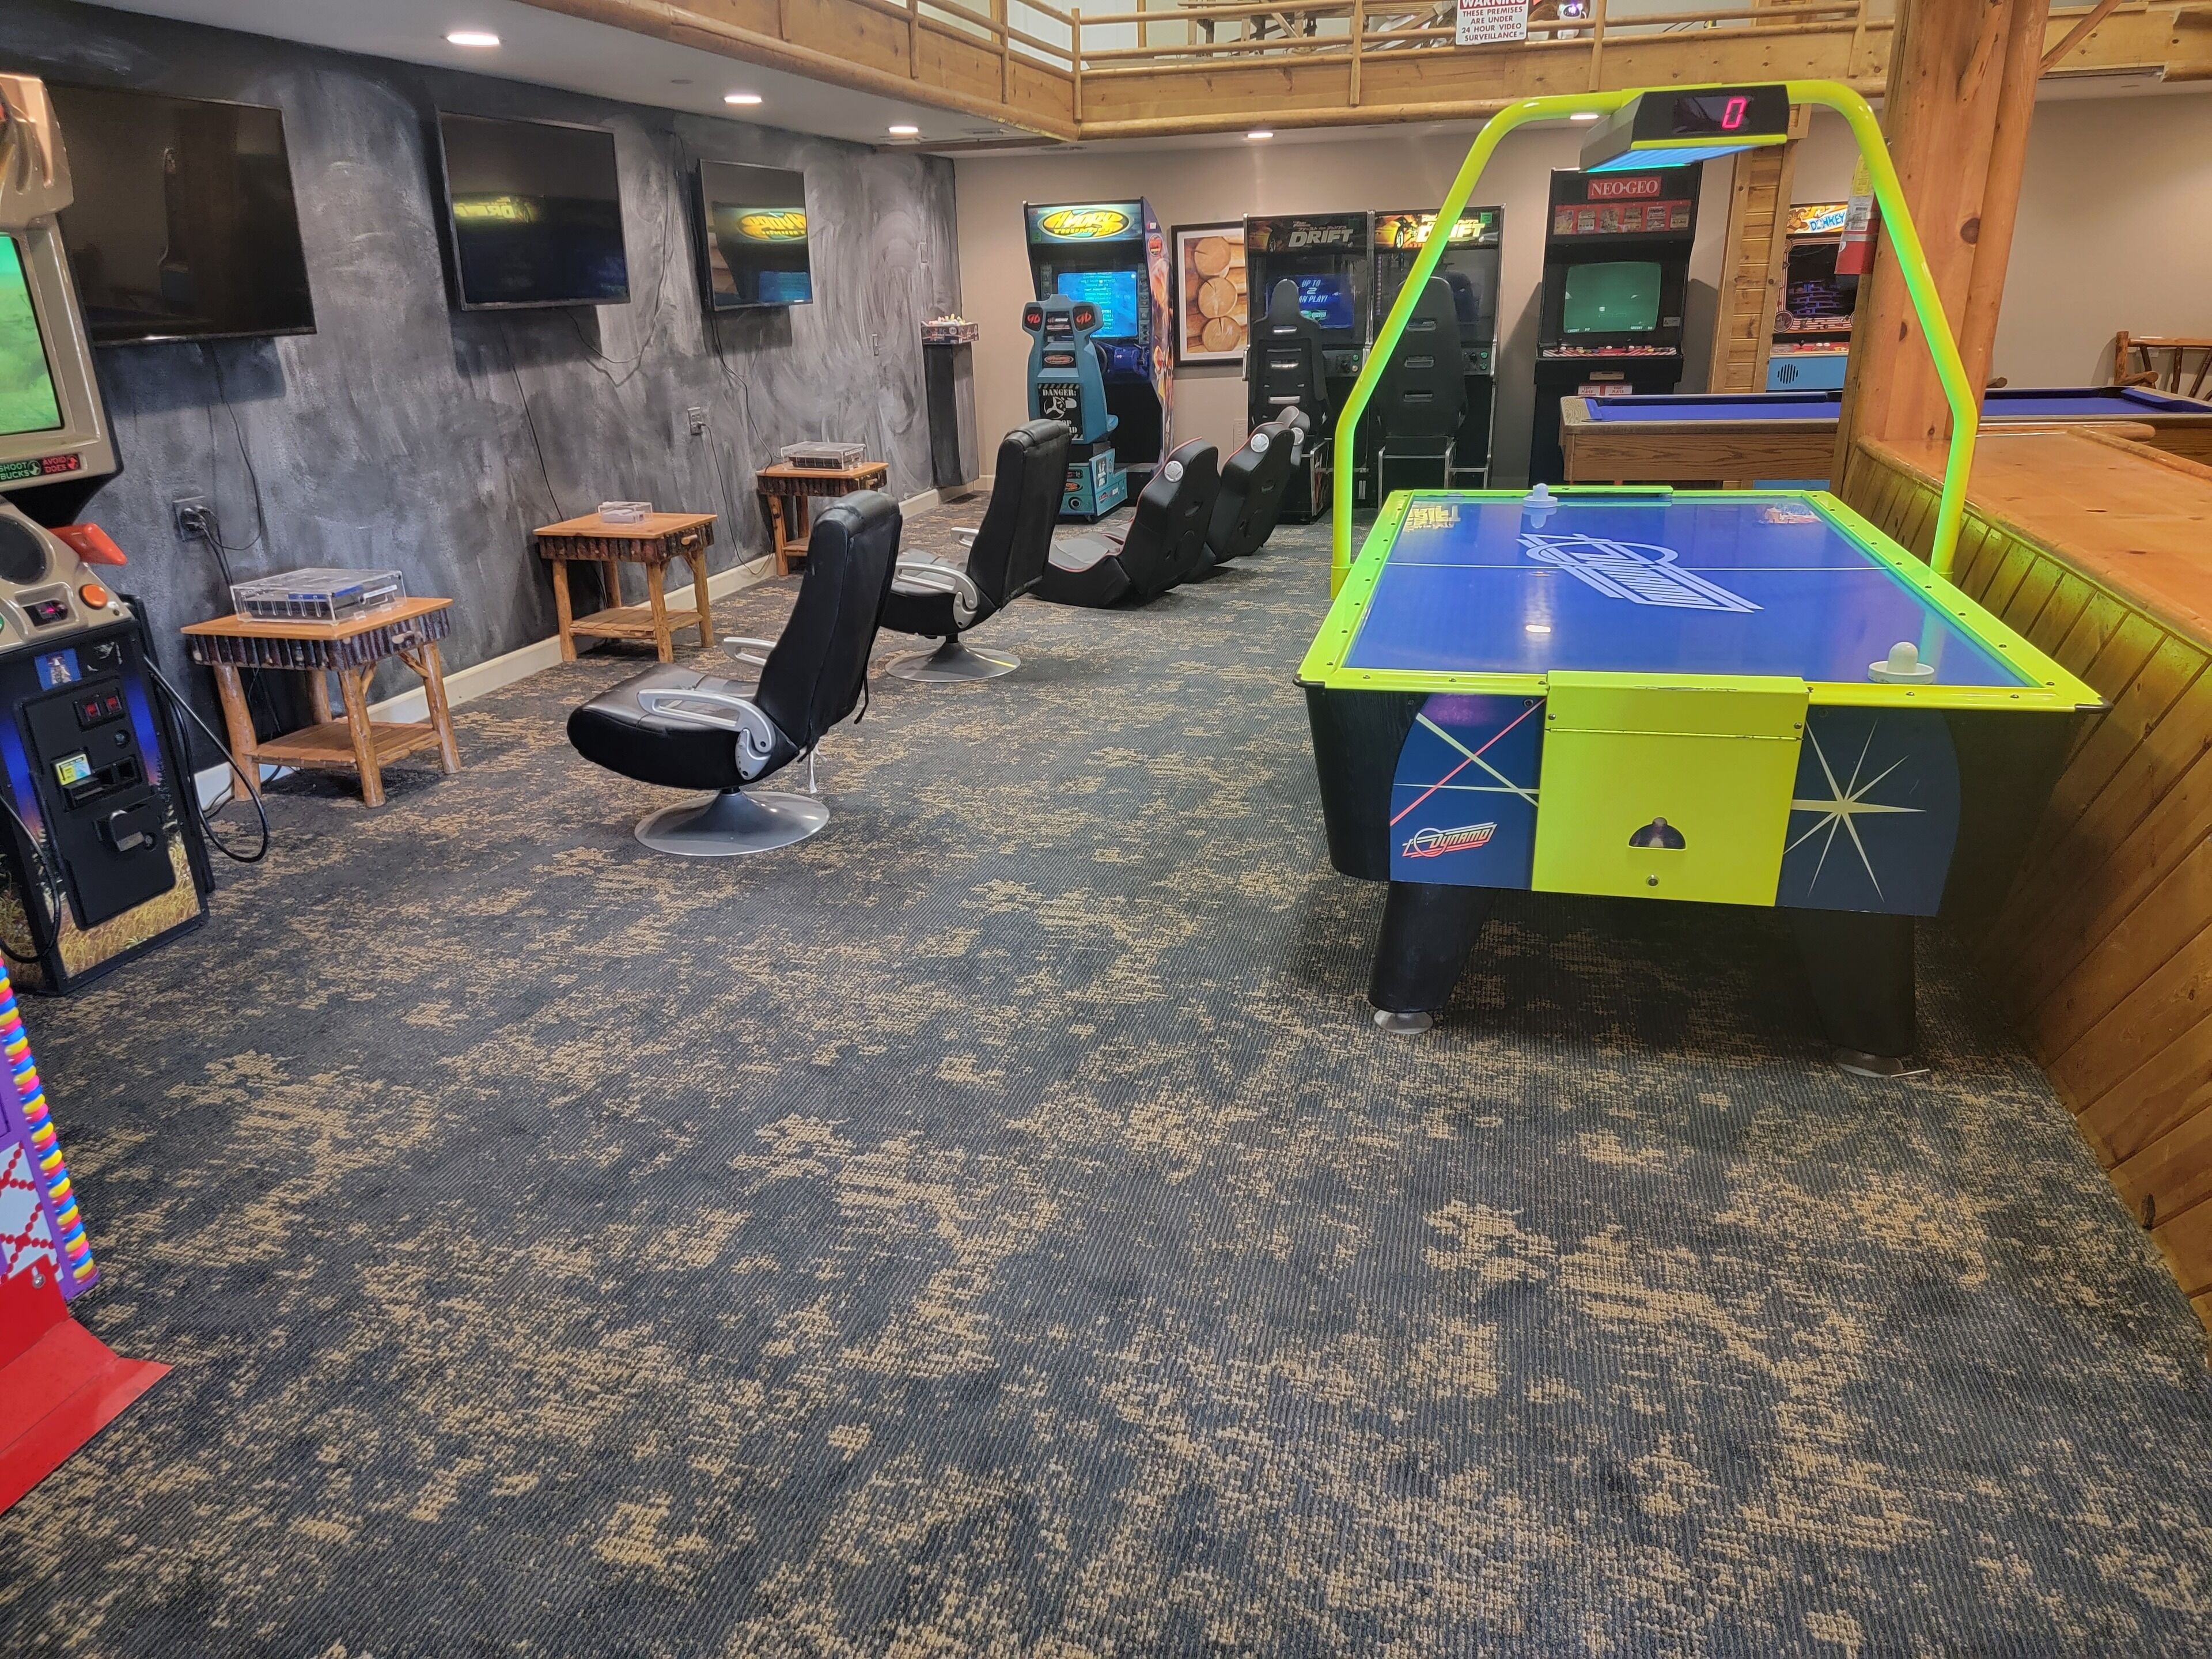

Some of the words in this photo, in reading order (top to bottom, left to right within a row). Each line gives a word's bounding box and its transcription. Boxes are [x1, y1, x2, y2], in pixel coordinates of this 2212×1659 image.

[1487, 6, 1522, 15] PREMISES
[1465, 32, 1517, 41] SURVEILLANCE
[1810, 211, 1845, 231] DONKEY
[1415, 223, 1486, 243] DIFT
[1288, 229, 1354, 247] DRIFT
[1308, 295, 1328, 303] PLAY!
[43, 456, 67, 465] AVOID
[0, 462, 28, 472] SHOOT
[44, 464, 67, 473] DOES
[1, 469, 30, 480] BUCKS
